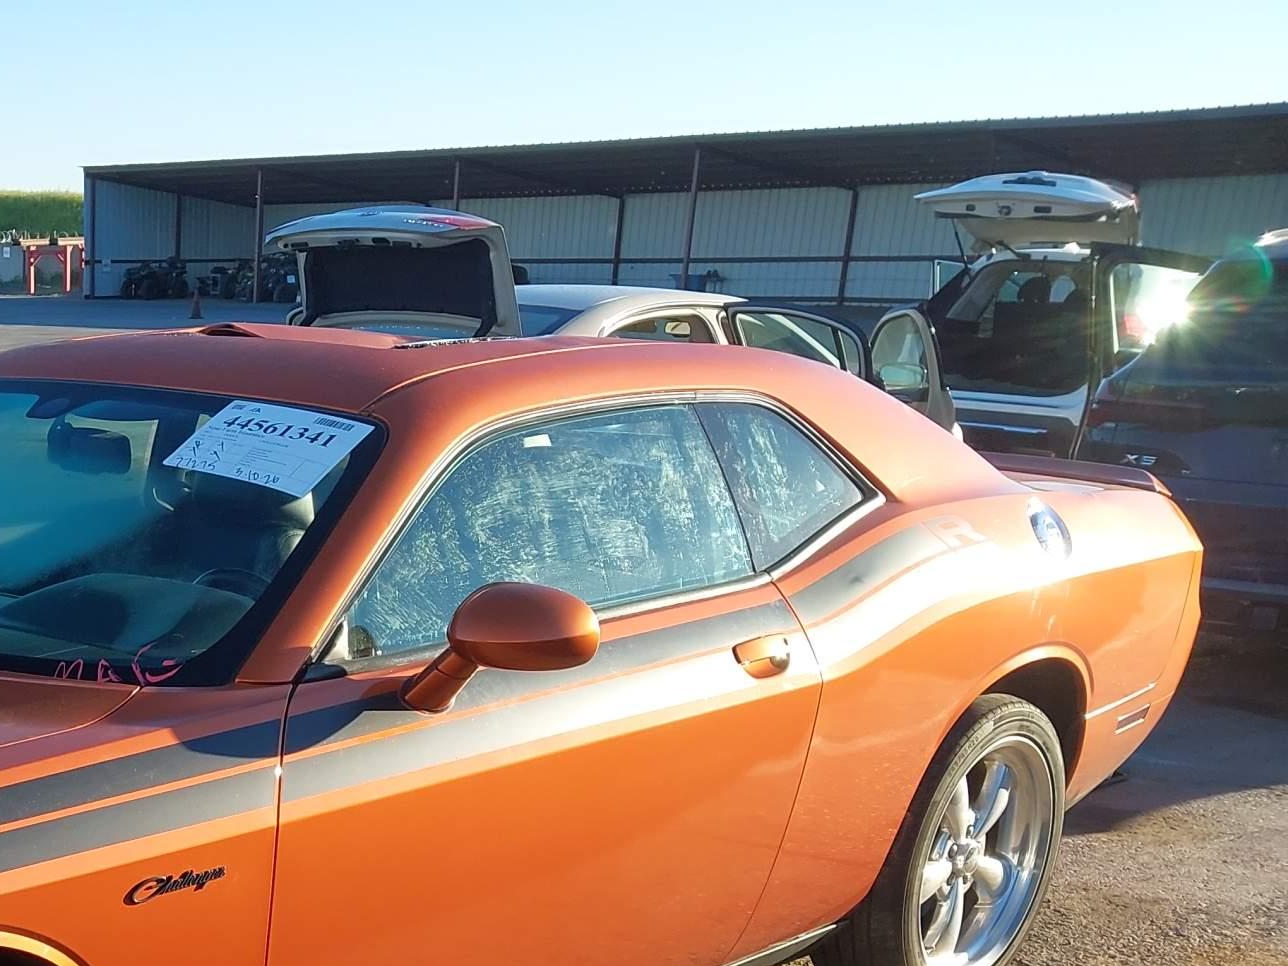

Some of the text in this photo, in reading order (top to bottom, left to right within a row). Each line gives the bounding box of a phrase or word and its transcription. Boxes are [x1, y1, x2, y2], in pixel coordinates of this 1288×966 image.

[223, 415, 337, 448] 44561341
[1119, 454, 1161, 466] X5
[123, 866, 227, 906] Challenger
